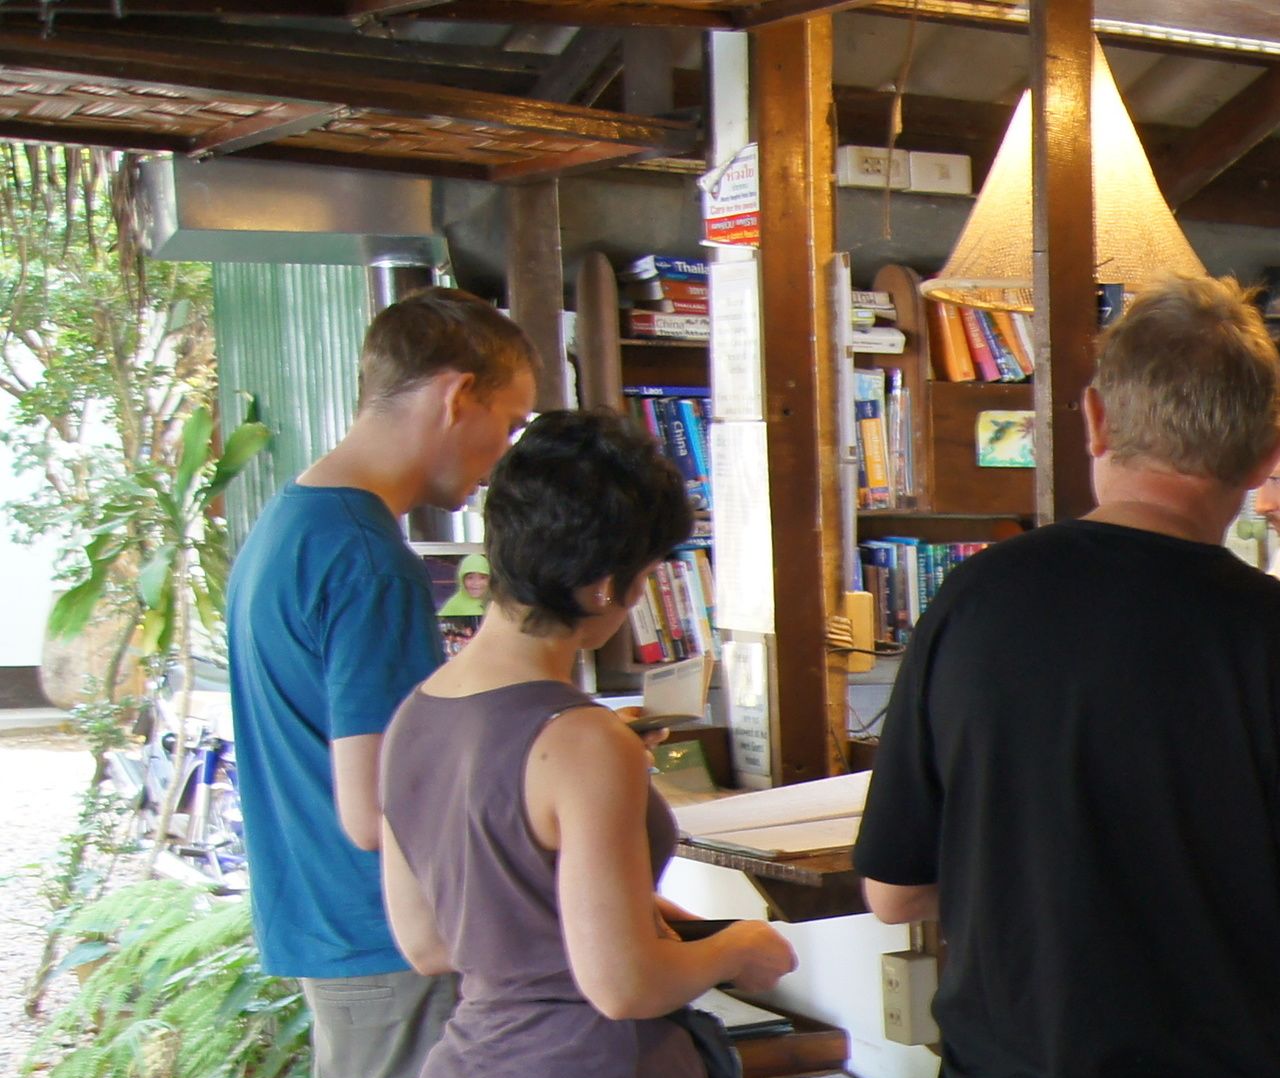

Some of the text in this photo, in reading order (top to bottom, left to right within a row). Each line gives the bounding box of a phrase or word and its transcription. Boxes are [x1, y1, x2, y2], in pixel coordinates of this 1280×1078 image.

[656, 319, 685, 330] China
[642, 387, 664, 396] Laos
[671, 421, 689, 457] China
